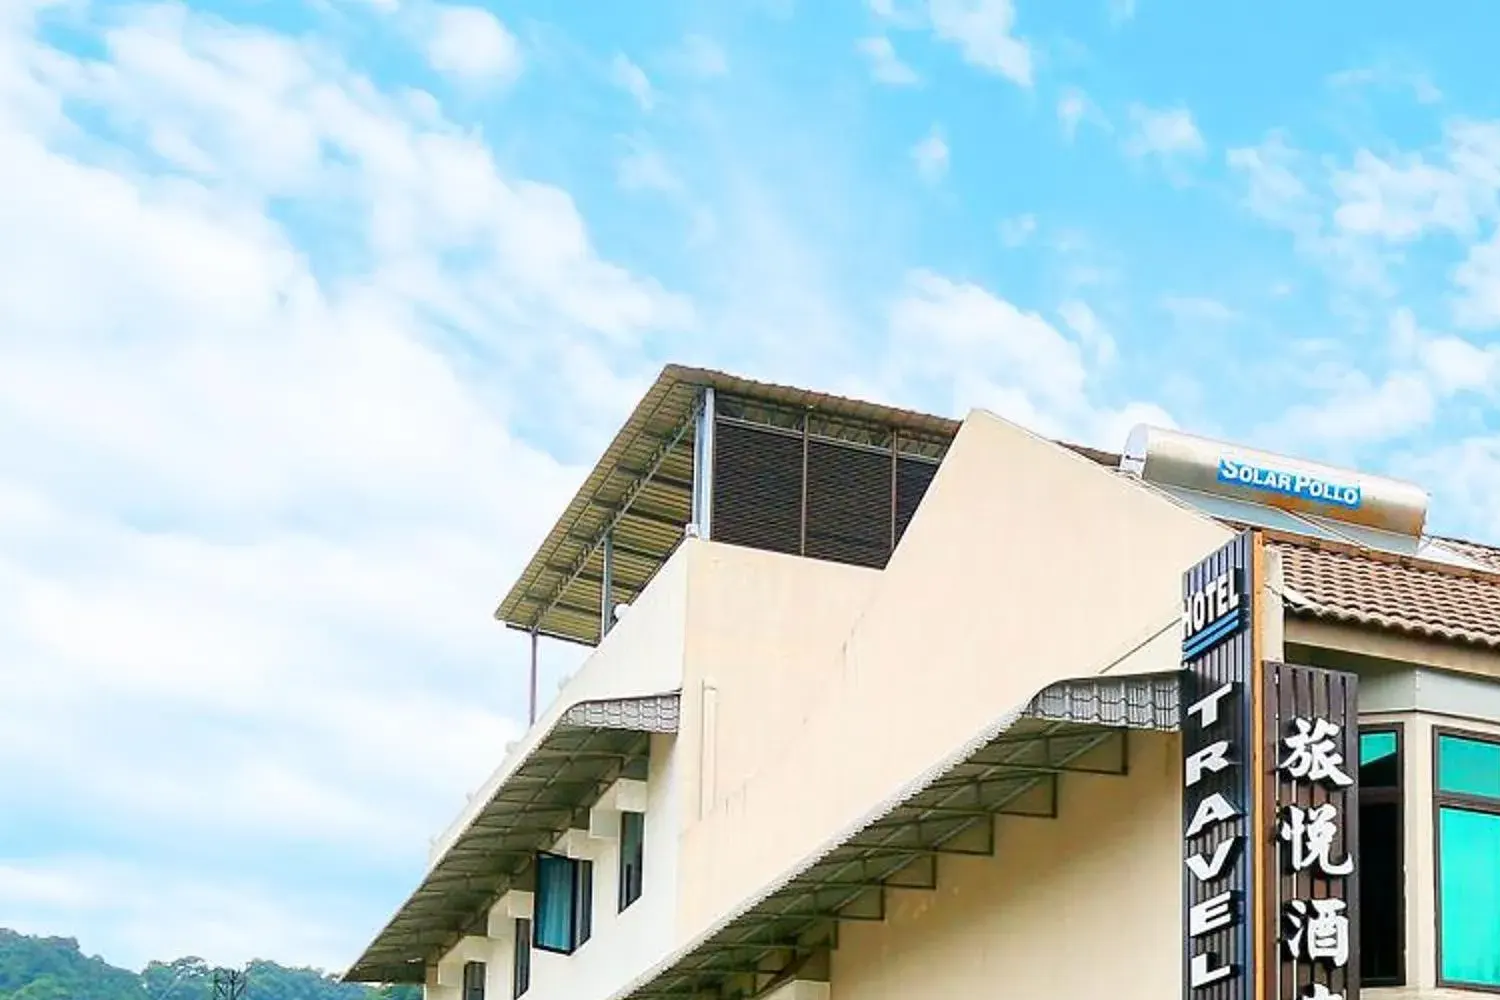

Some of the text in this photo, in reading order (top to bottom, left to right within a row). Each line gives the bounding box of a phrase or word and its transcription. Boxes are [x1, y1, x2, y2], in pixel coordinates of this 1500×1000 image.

[1220, 459, 1359, 505] SOLAR POLLO
[1181, 567, 1239, 640] HOTEL
